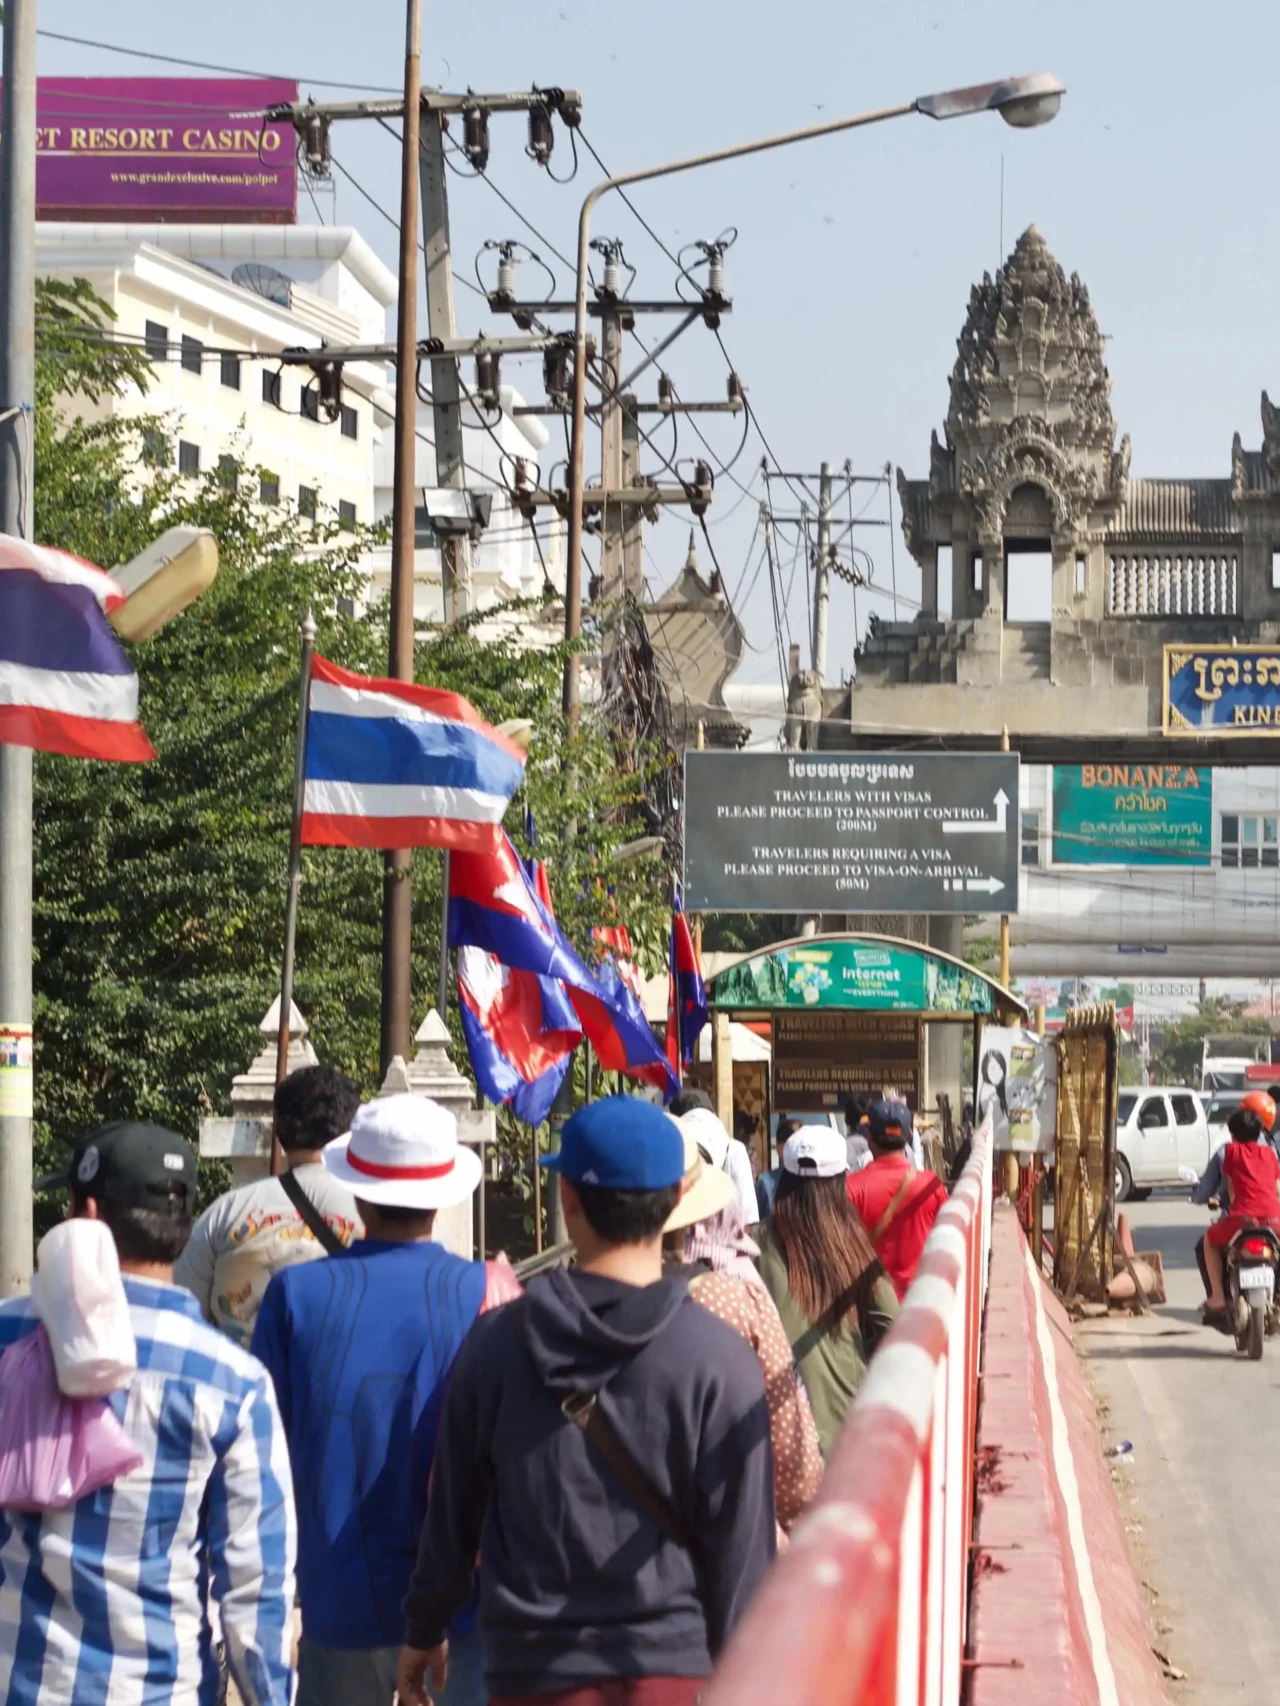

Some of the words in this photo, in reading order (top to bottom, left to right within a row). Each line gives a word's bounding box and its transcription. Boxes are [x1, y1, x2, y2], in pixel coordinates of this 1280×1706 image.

[70, 127, 174, 150] RESORT
[183, 128, 282, 151] CASINO
[1081, 764, 1200, 789] BONANZA
[773, 789, 851, 803] TRAVELERS
[855, 790, 891, 803] WITH
[894, 790, 932, 803] VISAS
[717, 805, 767, 819] PLEASE
[770, 805, 833, 819] PROCEED
[835, 806, 854, 819] TO
[856, 806, 921, 820] PASSPORT
[923, 806, 989, 820] CONTROL
[836, 819, 877, 833] (200M)
[752, 845, 829, 860] TRAVELERS
[832, 847, 908, 862] REQUIRING
[909, 848, 919, 861] A
[921, 848, 952, 861] VISA
[724, 862, 774, 876] PLEASE
[777, 863, 840, 877] PROCEED
[842, 863, 861, 877] TO
[842, 966, 901, 982] Internet
[776, 1082, 803, 1092] PLEASE
[804, 1082, 838, 1092] PROCEED
[840, 1082, 849, 1092] TO
[883, 1082, 915, 1092] IVAL
